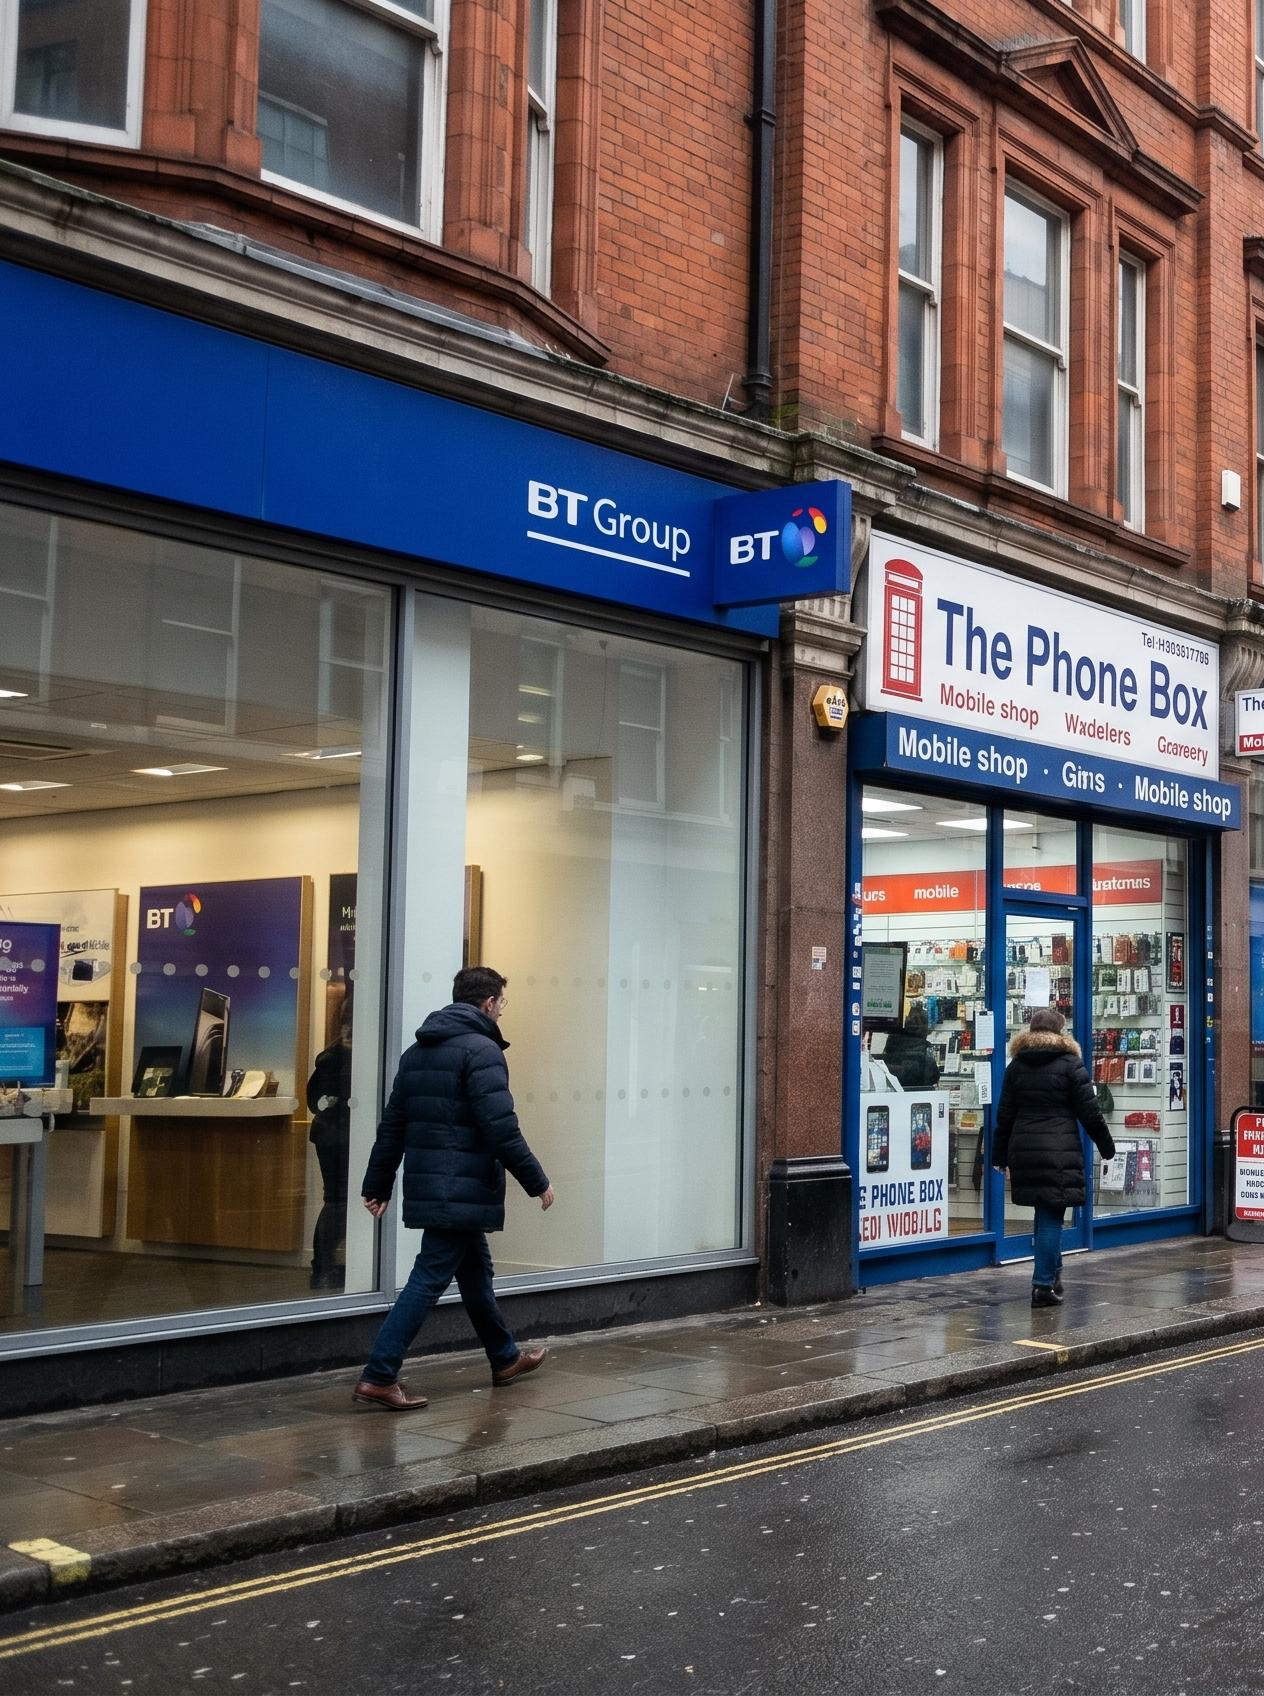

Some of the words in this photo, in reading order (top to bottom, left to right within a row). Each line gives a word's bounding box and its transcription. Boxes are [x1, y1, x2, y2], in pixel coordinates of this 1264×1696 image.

[528, 480, 588, 526] BT
[593, 498, 690, 562] Group
[729, 530, 779, 565] BT
[937, 598, 1012, 680] The
[1026, 624, 1138, 712] Phone
[1150, 660, 1208, 730] Box
[940, 683, 995, 716] Mobile
[1000, 700, 1039, 729] shop
[899, 727, 971, 768] Mobile
[978, 745, 1028, 784] shop
[1135, 775, 1188, 809] Mobile
[1193, 788, 1231, 821] shop
[914, 884, 959, 900] mobile
[147, 908, 173, 929] BT
[871, 1182, 915, 1208] PHONE
[919, 1179, 943, 1203] BOX
